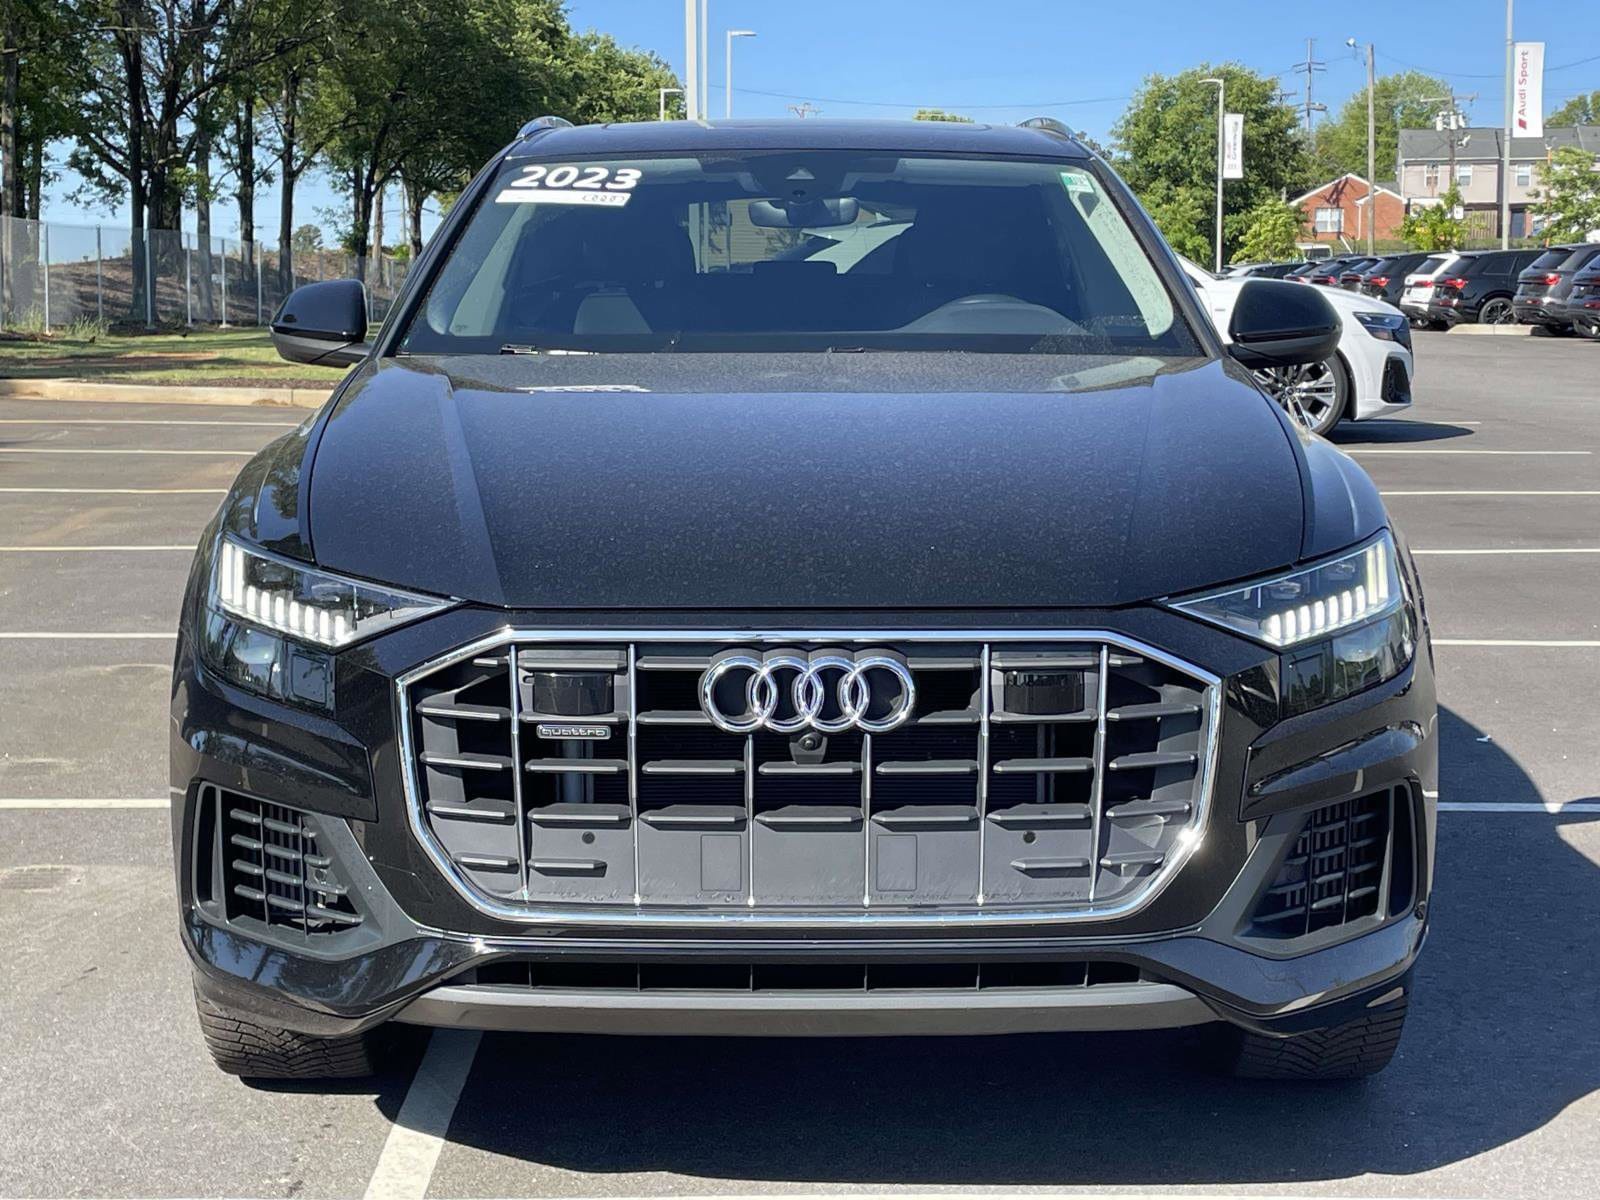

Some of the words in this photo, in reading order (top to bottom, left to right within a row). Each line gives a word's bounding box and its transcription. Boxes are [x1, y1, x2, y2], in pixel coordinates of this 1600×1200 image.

[1518, 50, 1529, 86] Sport
[1518, 89, 1527, 117] Audi
[511, 166, 642, 189] 2023
[540, 726, 607, 737] quattro
